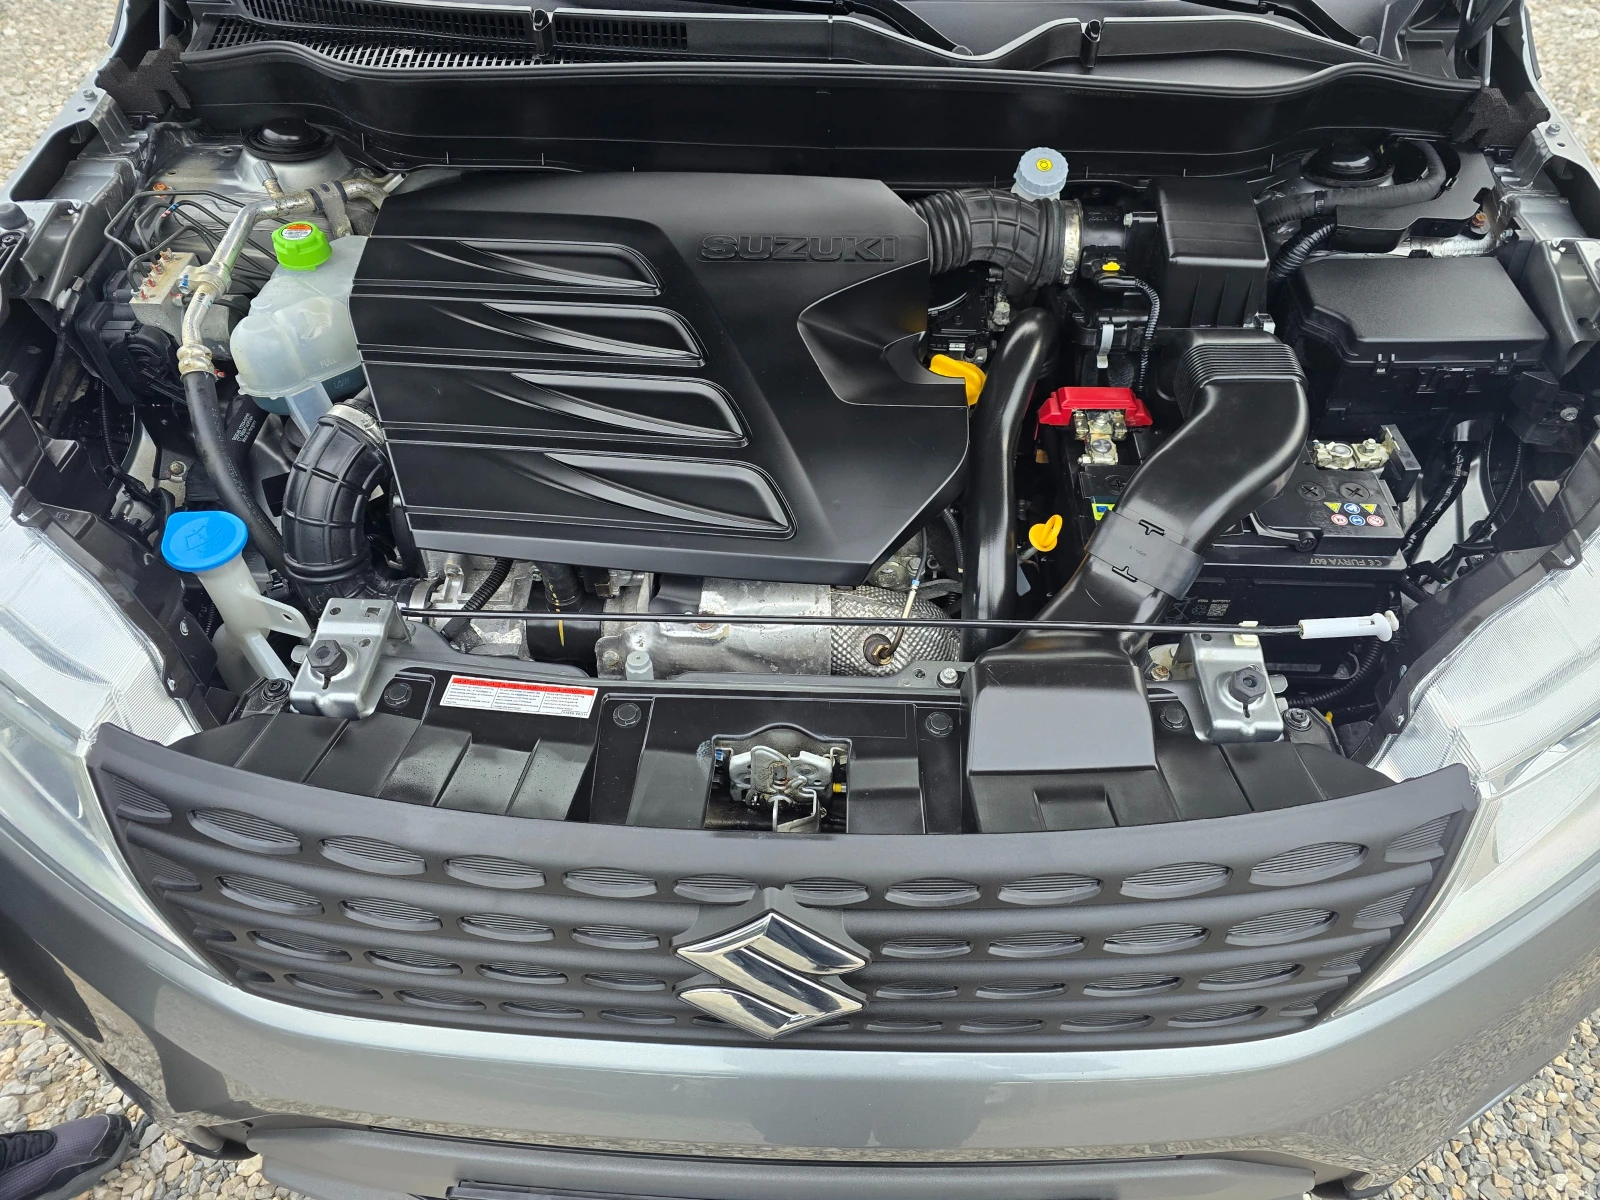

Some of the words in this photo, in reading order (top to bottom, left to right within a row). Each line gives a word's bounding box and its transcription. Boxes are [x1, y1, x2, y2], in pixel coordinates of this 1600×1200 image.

[701, 235, 896, 261] SUZUKI
[320, 358, 337, 368] FULL
[333, 377, 350, 389] LOW
[1328, 558, 1366, 566] FURYA
